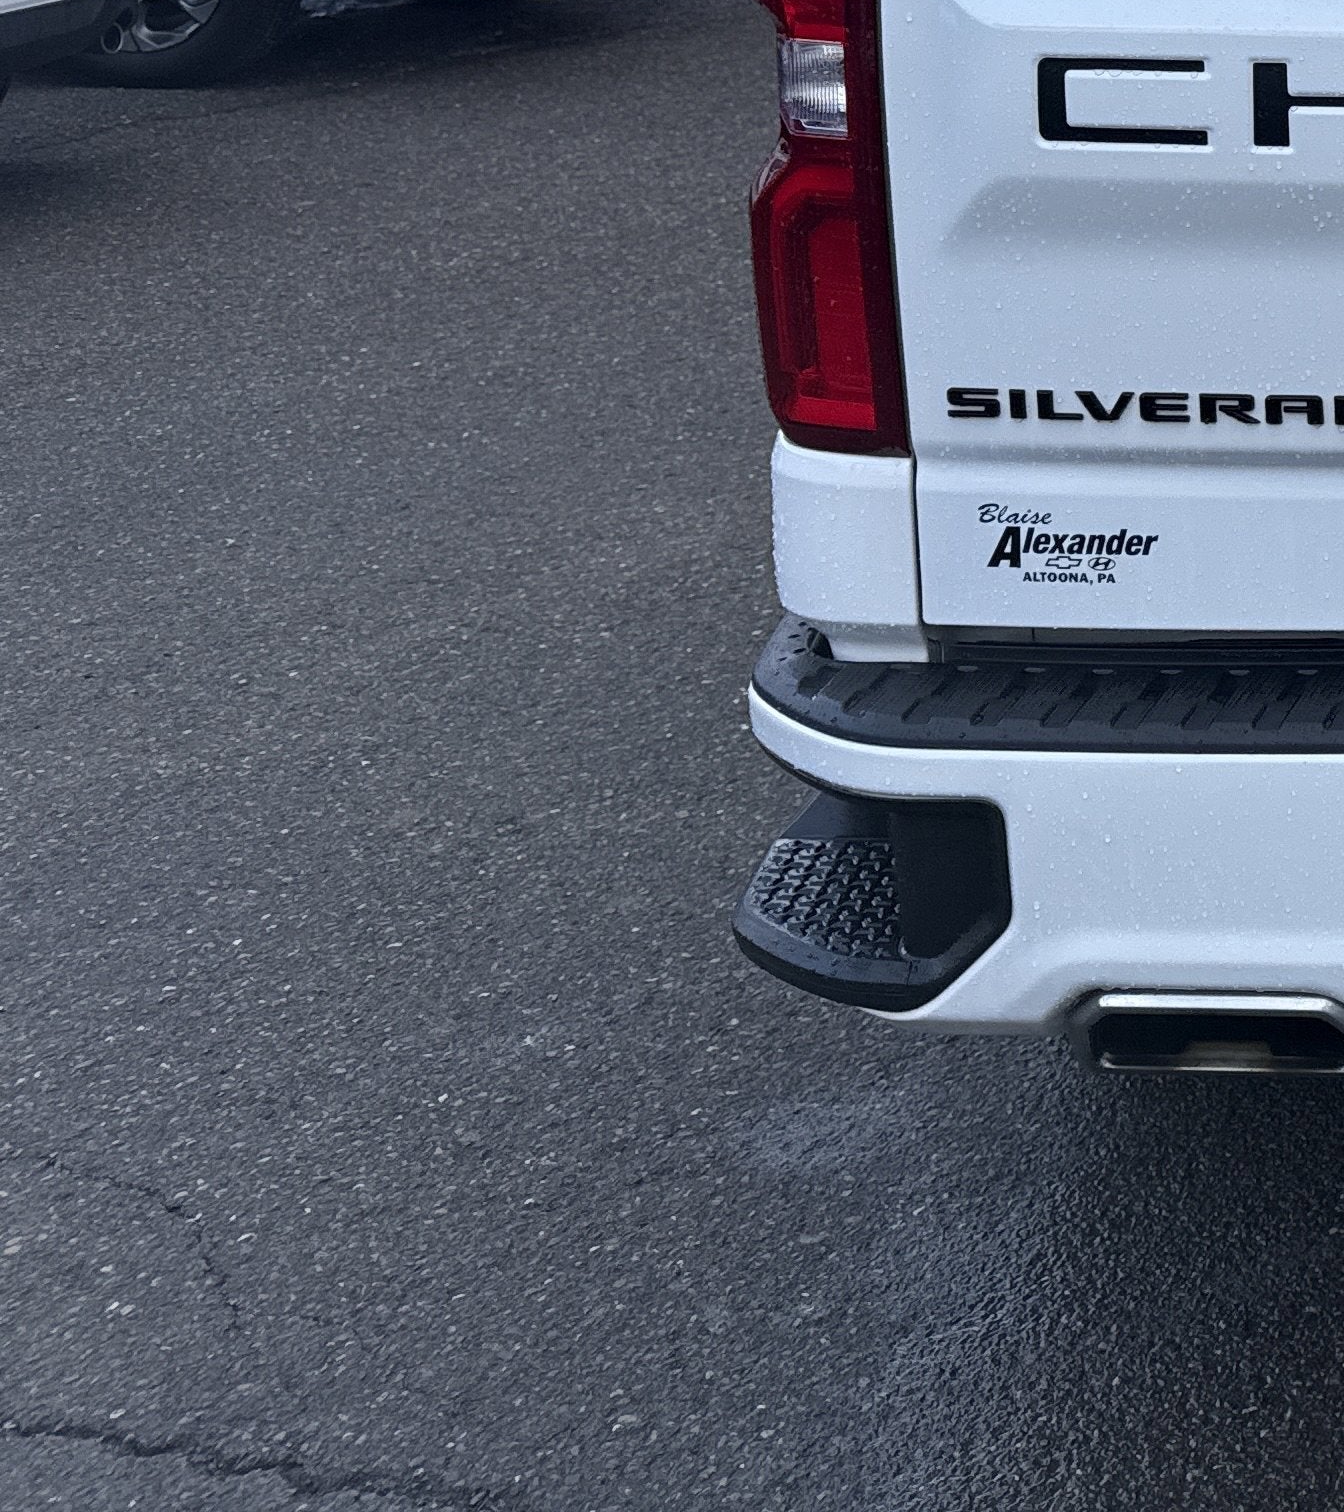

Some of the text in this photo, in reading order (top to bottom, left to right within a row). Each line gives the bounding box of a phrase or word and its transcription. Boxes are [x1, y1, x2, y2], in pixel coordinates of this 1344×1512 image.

[977, 503, 1052, 525] Blaise
[987, 526, 1159, 569] Alexander
[1022, 571, 1116, 586] ALTOONA, PA
